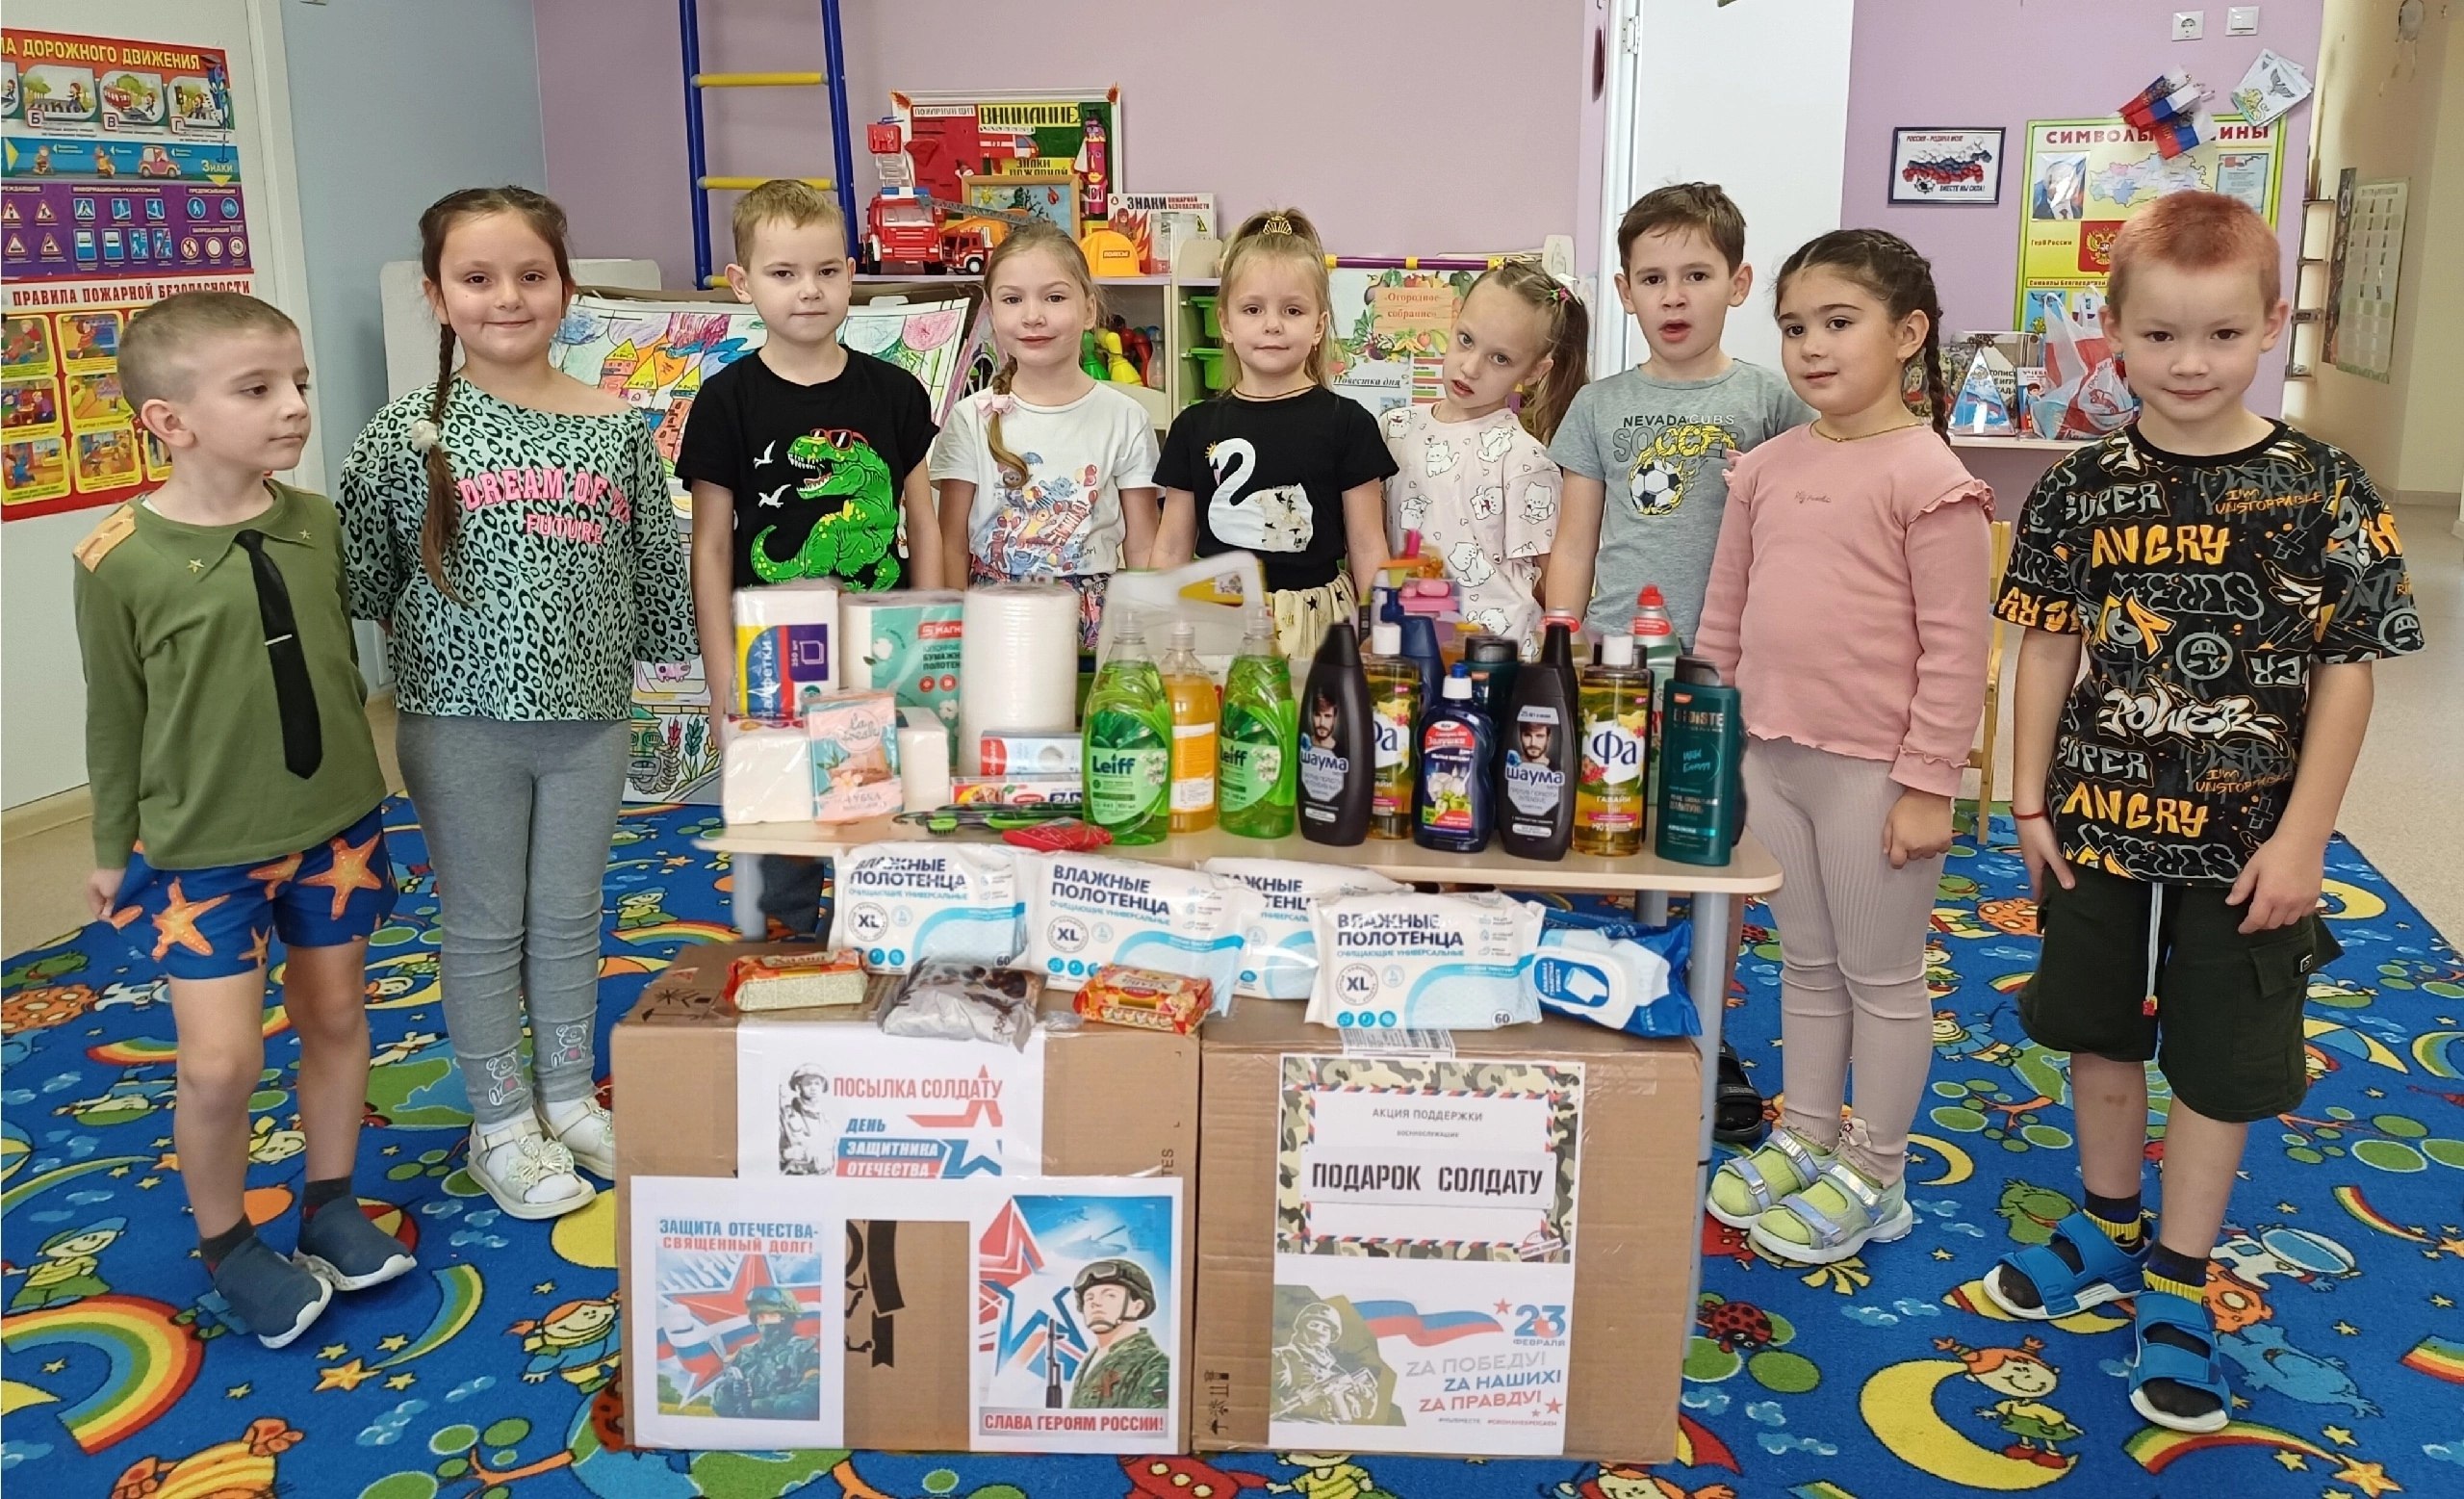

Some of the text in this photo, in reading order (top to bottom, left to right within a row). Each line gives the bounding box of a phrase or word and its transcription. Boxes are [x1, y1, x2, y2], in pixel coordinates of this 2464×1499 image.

[23, 39, 117, 64] ДОРОЖНОГО
[122, 48, 200, 70] ДВИЖЕНИЯ
[107, 116, 116, 128] В
[2045, 125, 2270, 145] СИМВОЛЫ ИНЫ
[1127, 195, 1168, 210] ЗНАКИ
[13, 291, 78, 306] ПРАВИЛА
[83, 282, 154, 303] ПОЖАРНОЙ
[1333, 375, 1400, 386] Повестка дня
[1623, 413, 1735, 428] NEVADA CUBS
[458, 467, 565, 512] DREAM
[574, 471, 609, 507] OF
[2065, 482, 2163, 526] SUPER
[2215, 491, 2323, 515] UNSTOPPABLE
[526, 513, 603, 544] FUTURE
[2091, 524, 2231, 569] ANGRY
[1592, 730, 1637, 765] Фа
[2057, 735, 2149, 780] SUPER
[1092, 753, 1136, 775] Leiff
[2061, 780, 2210, 839] ANGRY
[850, 870, 966, 892] ПОЛОТЕНЦА
[1053, 864, 1152, 894] ВЛАЖНЫЕ
[1051, 882, 1171, 916] ПОЛОТЕНЦА
[858, 915, 880, 928] XL
[1337, 914, 1440, 930] ВЛАЖНЫЕ
[1057, 927, 1080, 942] XL
[1337, 930, 1464, 948] ПОЛОТЕНЦА
[995, 955, 1011, 967] 60
[1347, 976, 1370, 991] XL
[1494, 1013, 1510, 1024] 60
[834, 1076, 1004, 1101] ПОСЫЛКА СОЛДАТУ
[845, 1117, 886, 1134] ДЕНЬ
[1373, 1108, 1483, 1123] АКЦИЯ ПОДДЕРЖКИ
[846, 1140, 939, 1158] ЗАЩИТНИКА
[846, 1161, 930, 1177] ОТЕЧЕСТВА
[1312, 1162, 1544, 1196] ПОДАРОК СОЛДАТУ
[659, 1219, 819, 1239] ЗАЩИТА ОТЕЧЕСТВА-
[662, 1236, 813, 1254] СВЯЩЕННЫЙ ДОЛГ!
[1514, 1304, 1567, 1338] 23
[1512, 1337, 1566, 1347] ФЕВРАЛЯ
[1443, 1351, 1546, 1375] ПОБЕДУ!
[1476, 1369, 1561, 1391] НАШИХ!
[1450, 1390, 1542, 1412] ПРАВДУ!
[985, 1413, 1165, 1433] СЛАВА ГЕРОЯМ РОССИИ!
